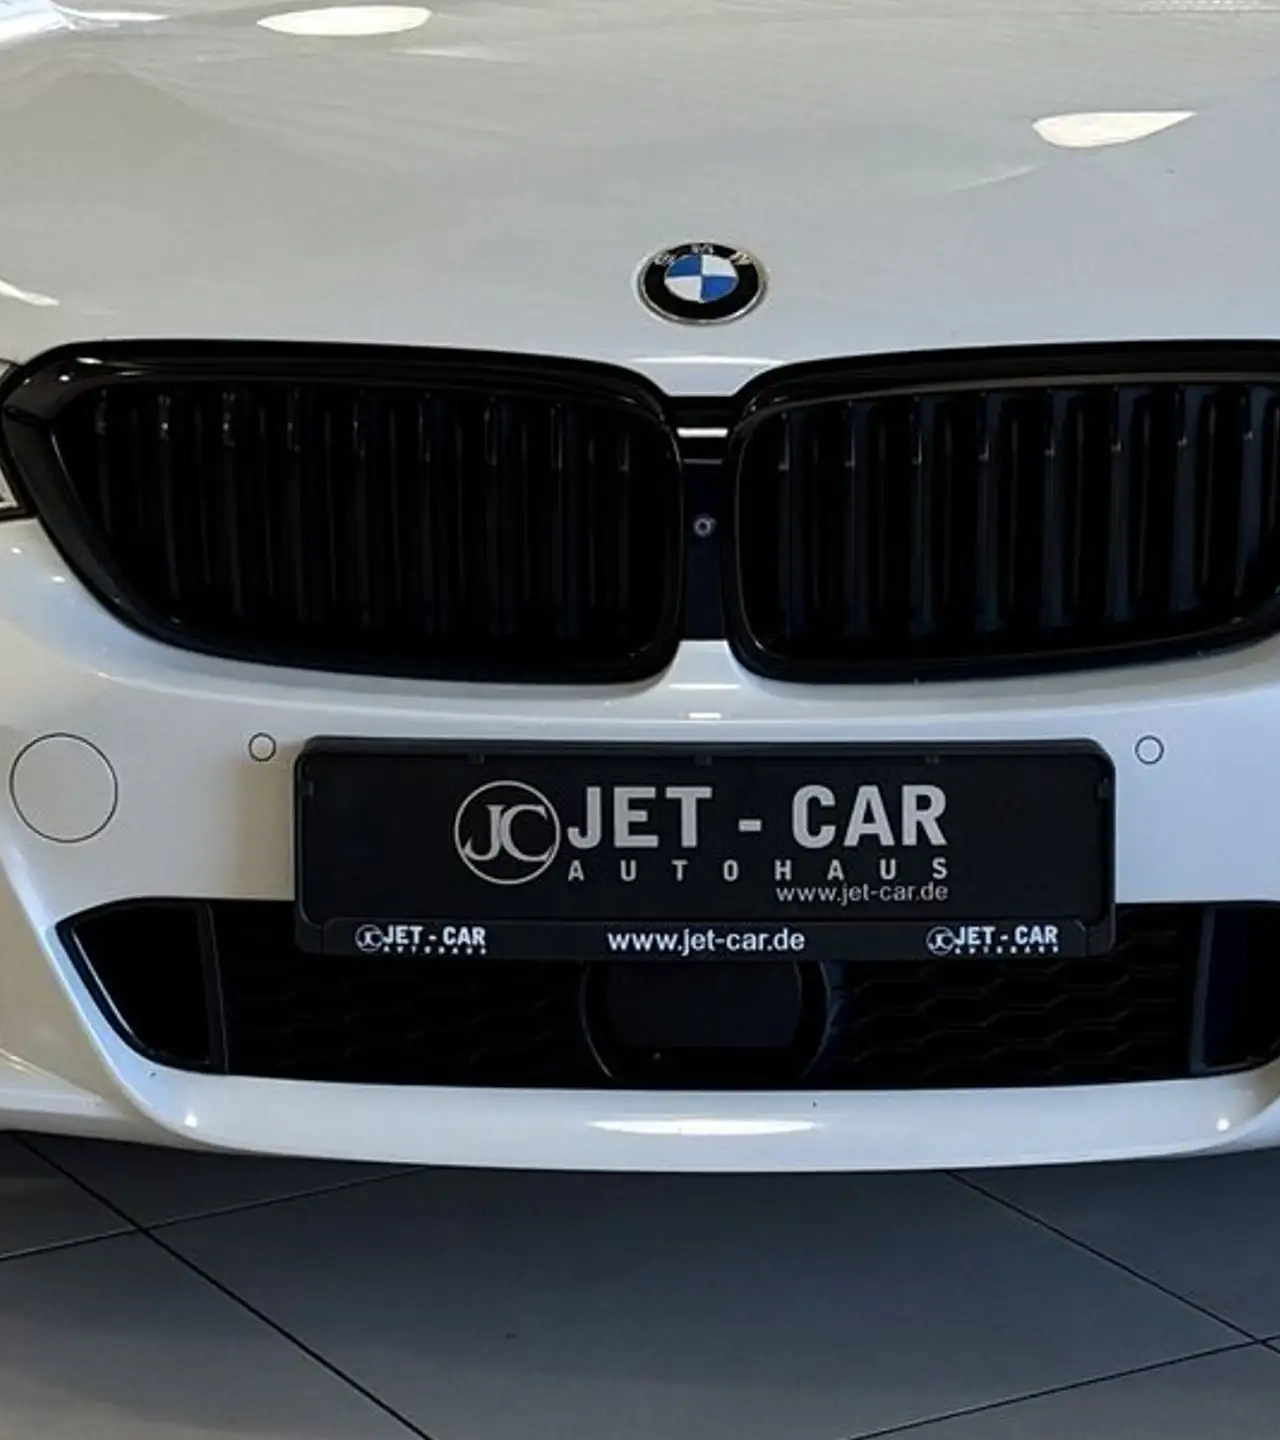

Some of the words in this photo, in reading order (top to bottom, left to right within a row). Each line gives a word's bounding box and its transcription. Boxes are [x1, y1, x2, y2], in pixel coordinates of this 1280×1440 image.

[566, 786, 713, 849] JET
[791, 784, 948, 849] CAR
[567, 857, 949, 882] AUTOHAUS
[775, 881, 949, 906] www.jet-car.de
[383, 924, 423, 944] JET
[442, 926, 486, 946] CAR
[606, 927, 806, 957] www.jet-car.de
[954, 925, 996, 945] JET
[1014, 925, 1058, 945] CAR
